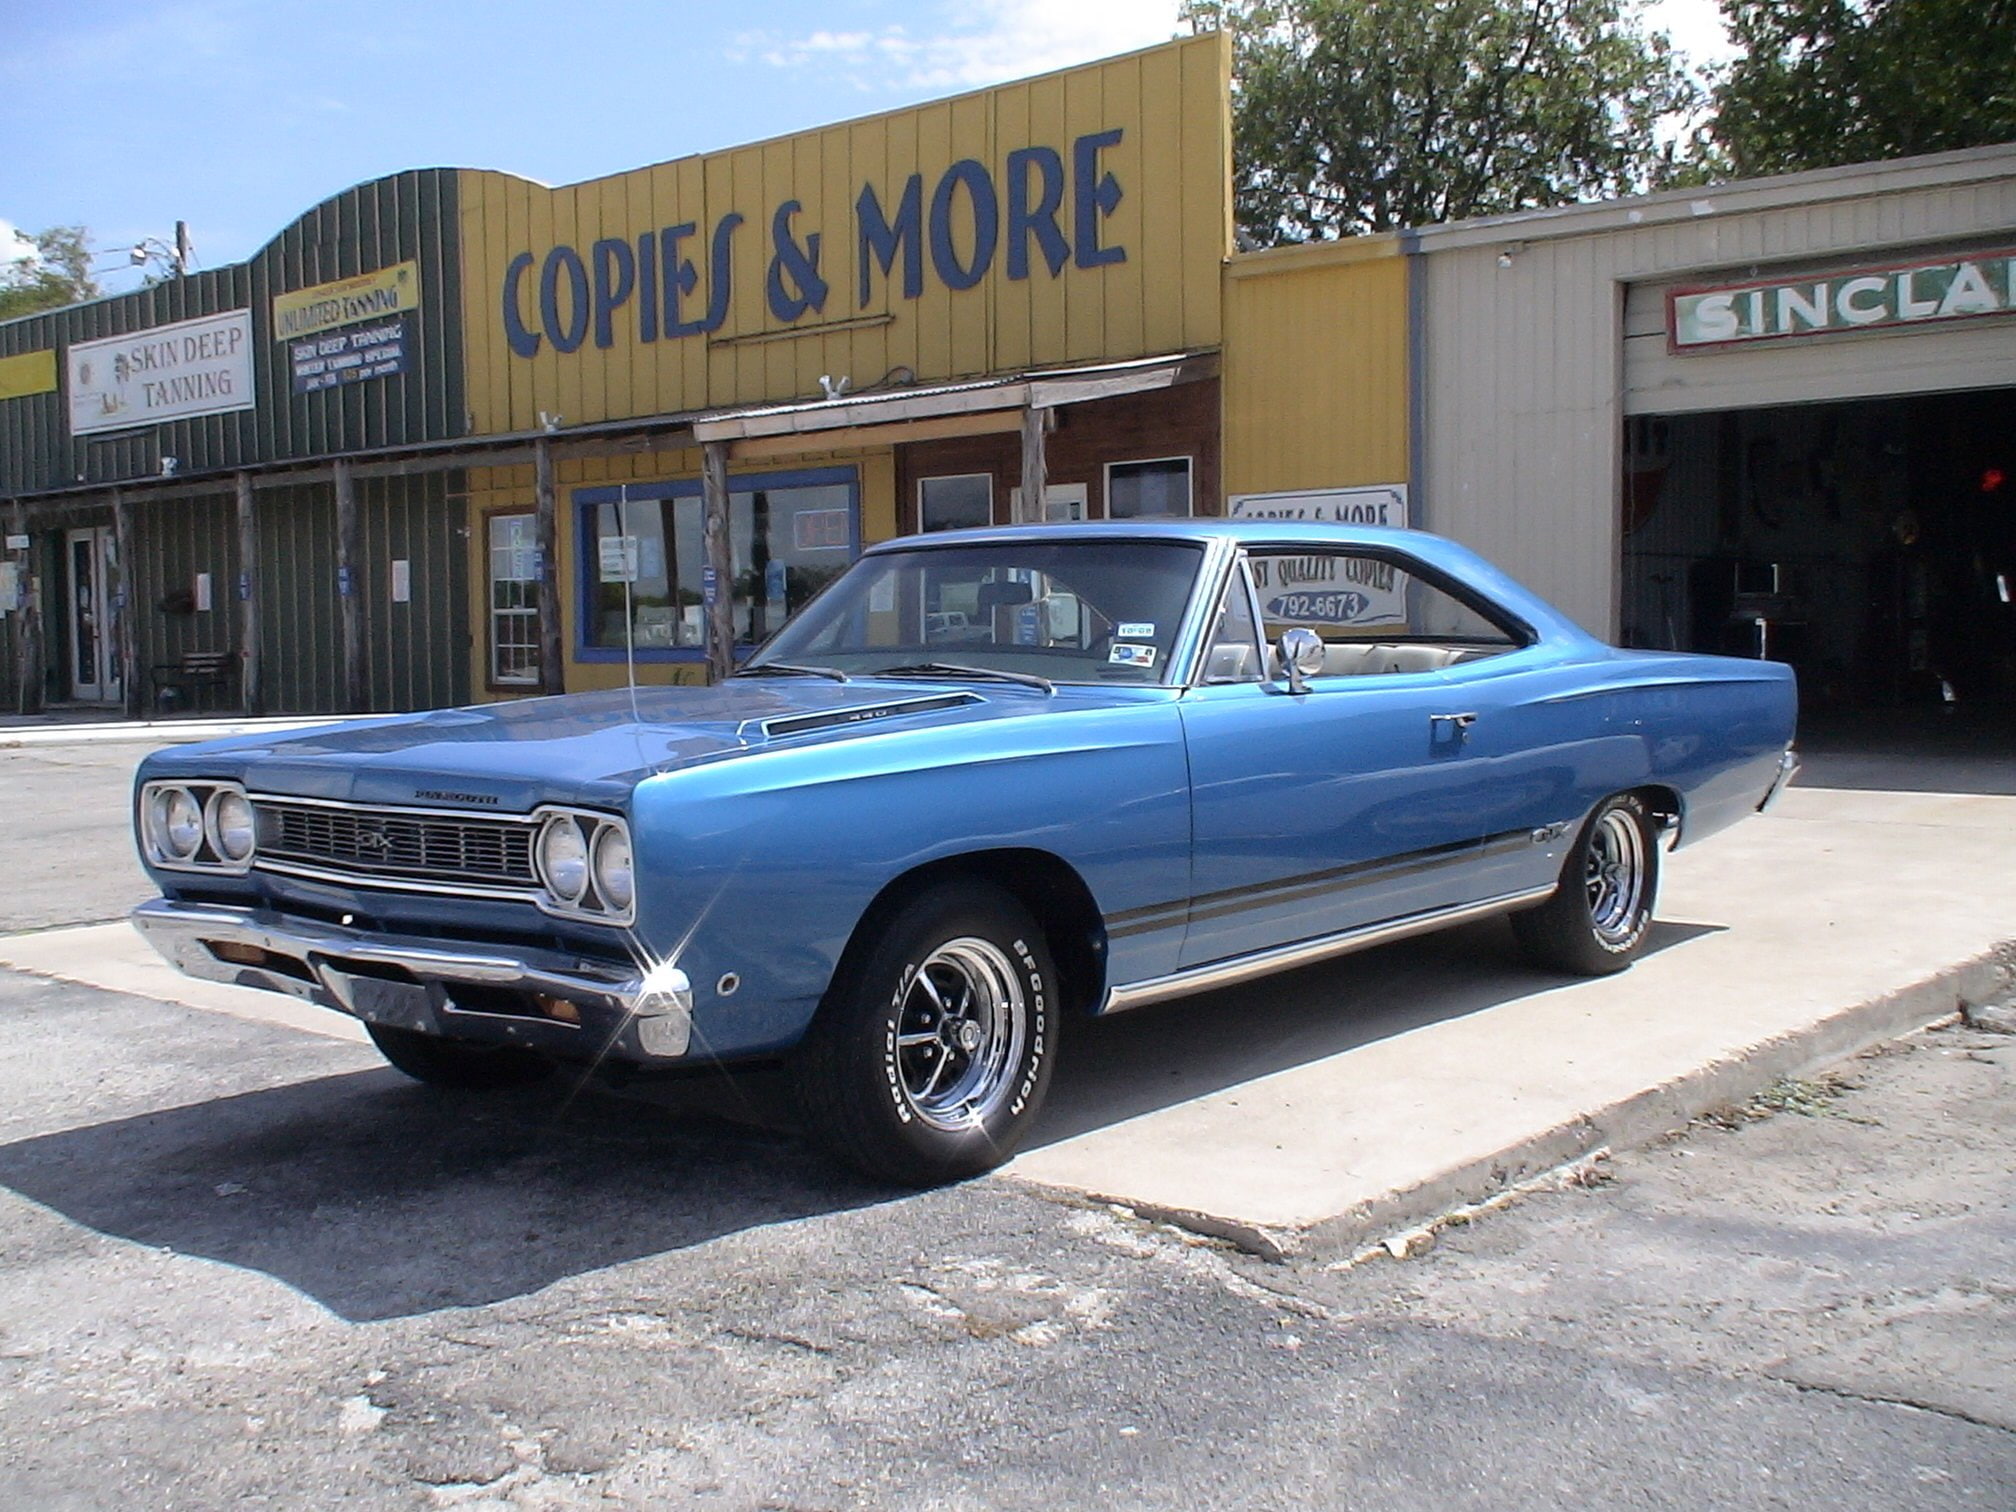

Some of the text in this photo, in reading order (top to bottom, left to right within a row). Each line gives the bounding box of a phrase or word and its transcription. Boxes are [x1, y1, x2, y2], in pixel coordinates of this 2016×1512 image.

[503, 128, 1127, 358] COPIES & MORE
[342, 285, 399, 320] TANNING
[131, 327, 242, 373] SKIN DEEP
[142, 370, 232, 408] TANNING
[1278, 556, 1335, 587] QUALITY
[1346, 558, 1397, 593] COPIES
[1279, 593, 1360, 618] 792-6673
